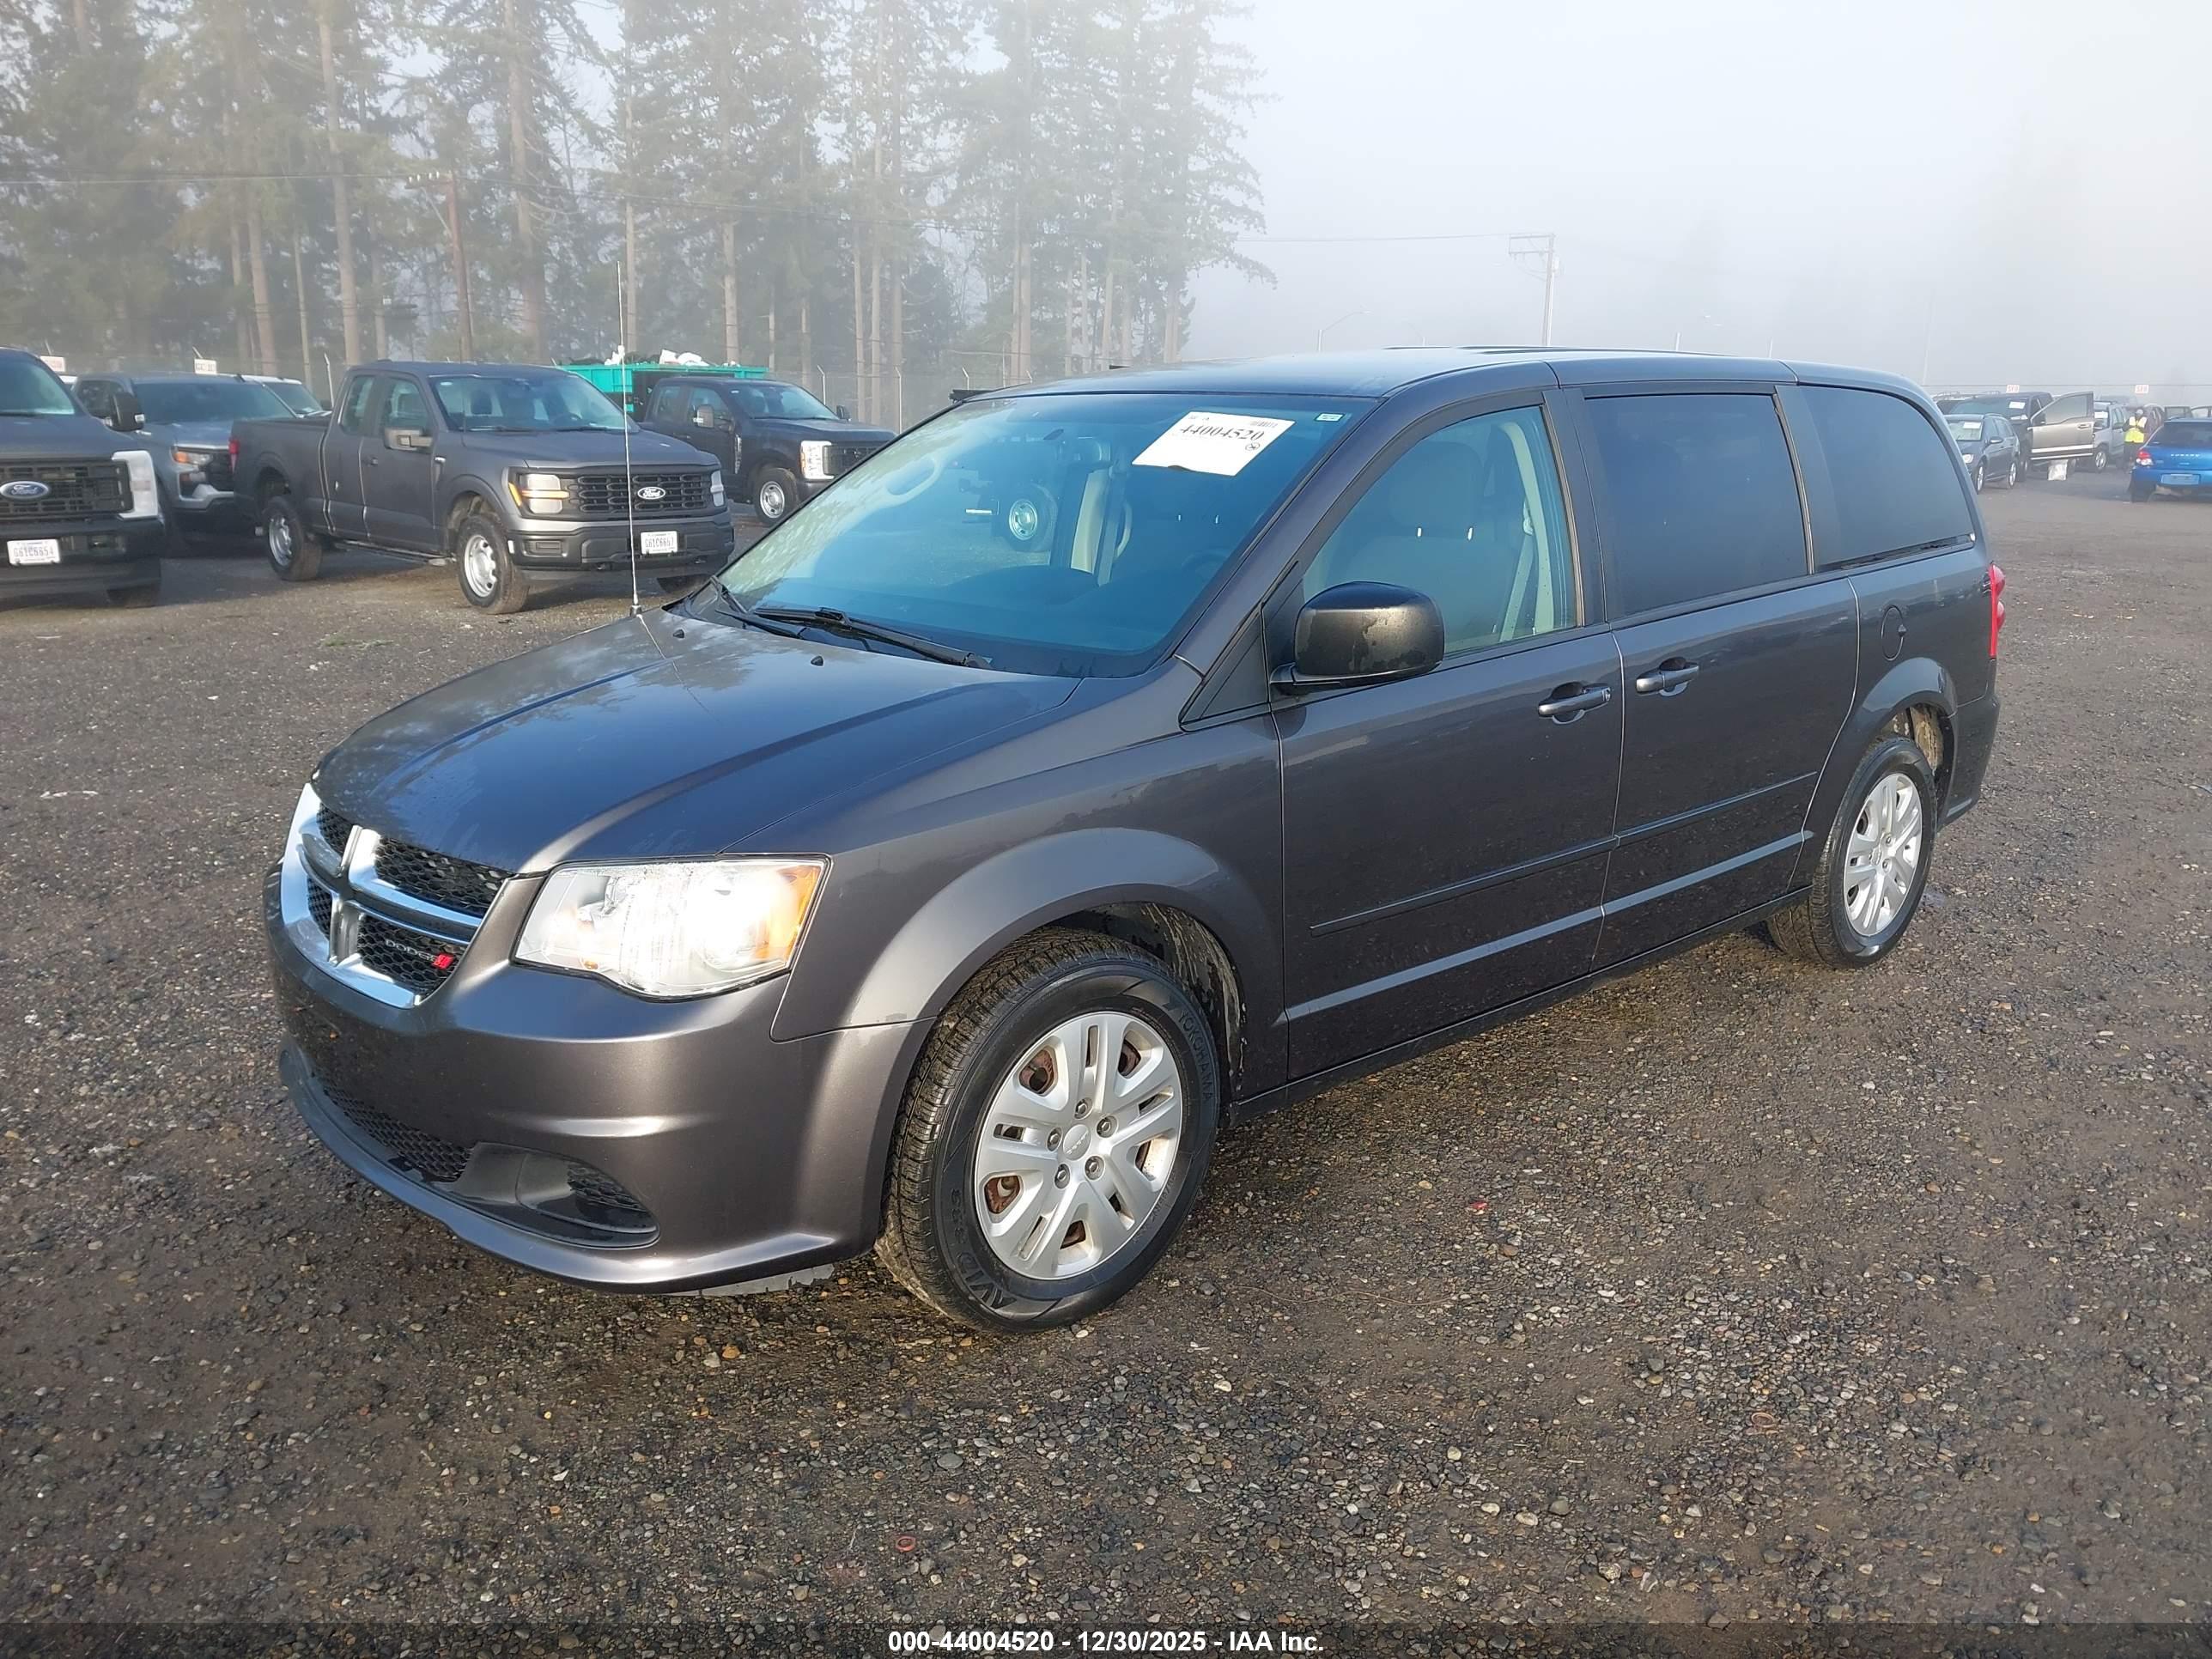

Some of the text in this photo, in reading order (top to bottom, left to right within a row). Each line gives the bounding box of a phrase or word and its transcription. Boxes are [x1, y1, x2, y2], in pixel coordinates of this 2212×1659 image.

[1180, 424, 1265, 441] 44004520
[11, 484, 38, 495] Ford
[386, 939, 436, 962] DODGE
[1178, 1010, 1213, 1100] YOKOHAMA
[957, 1252, 1018, 1310] AVID
